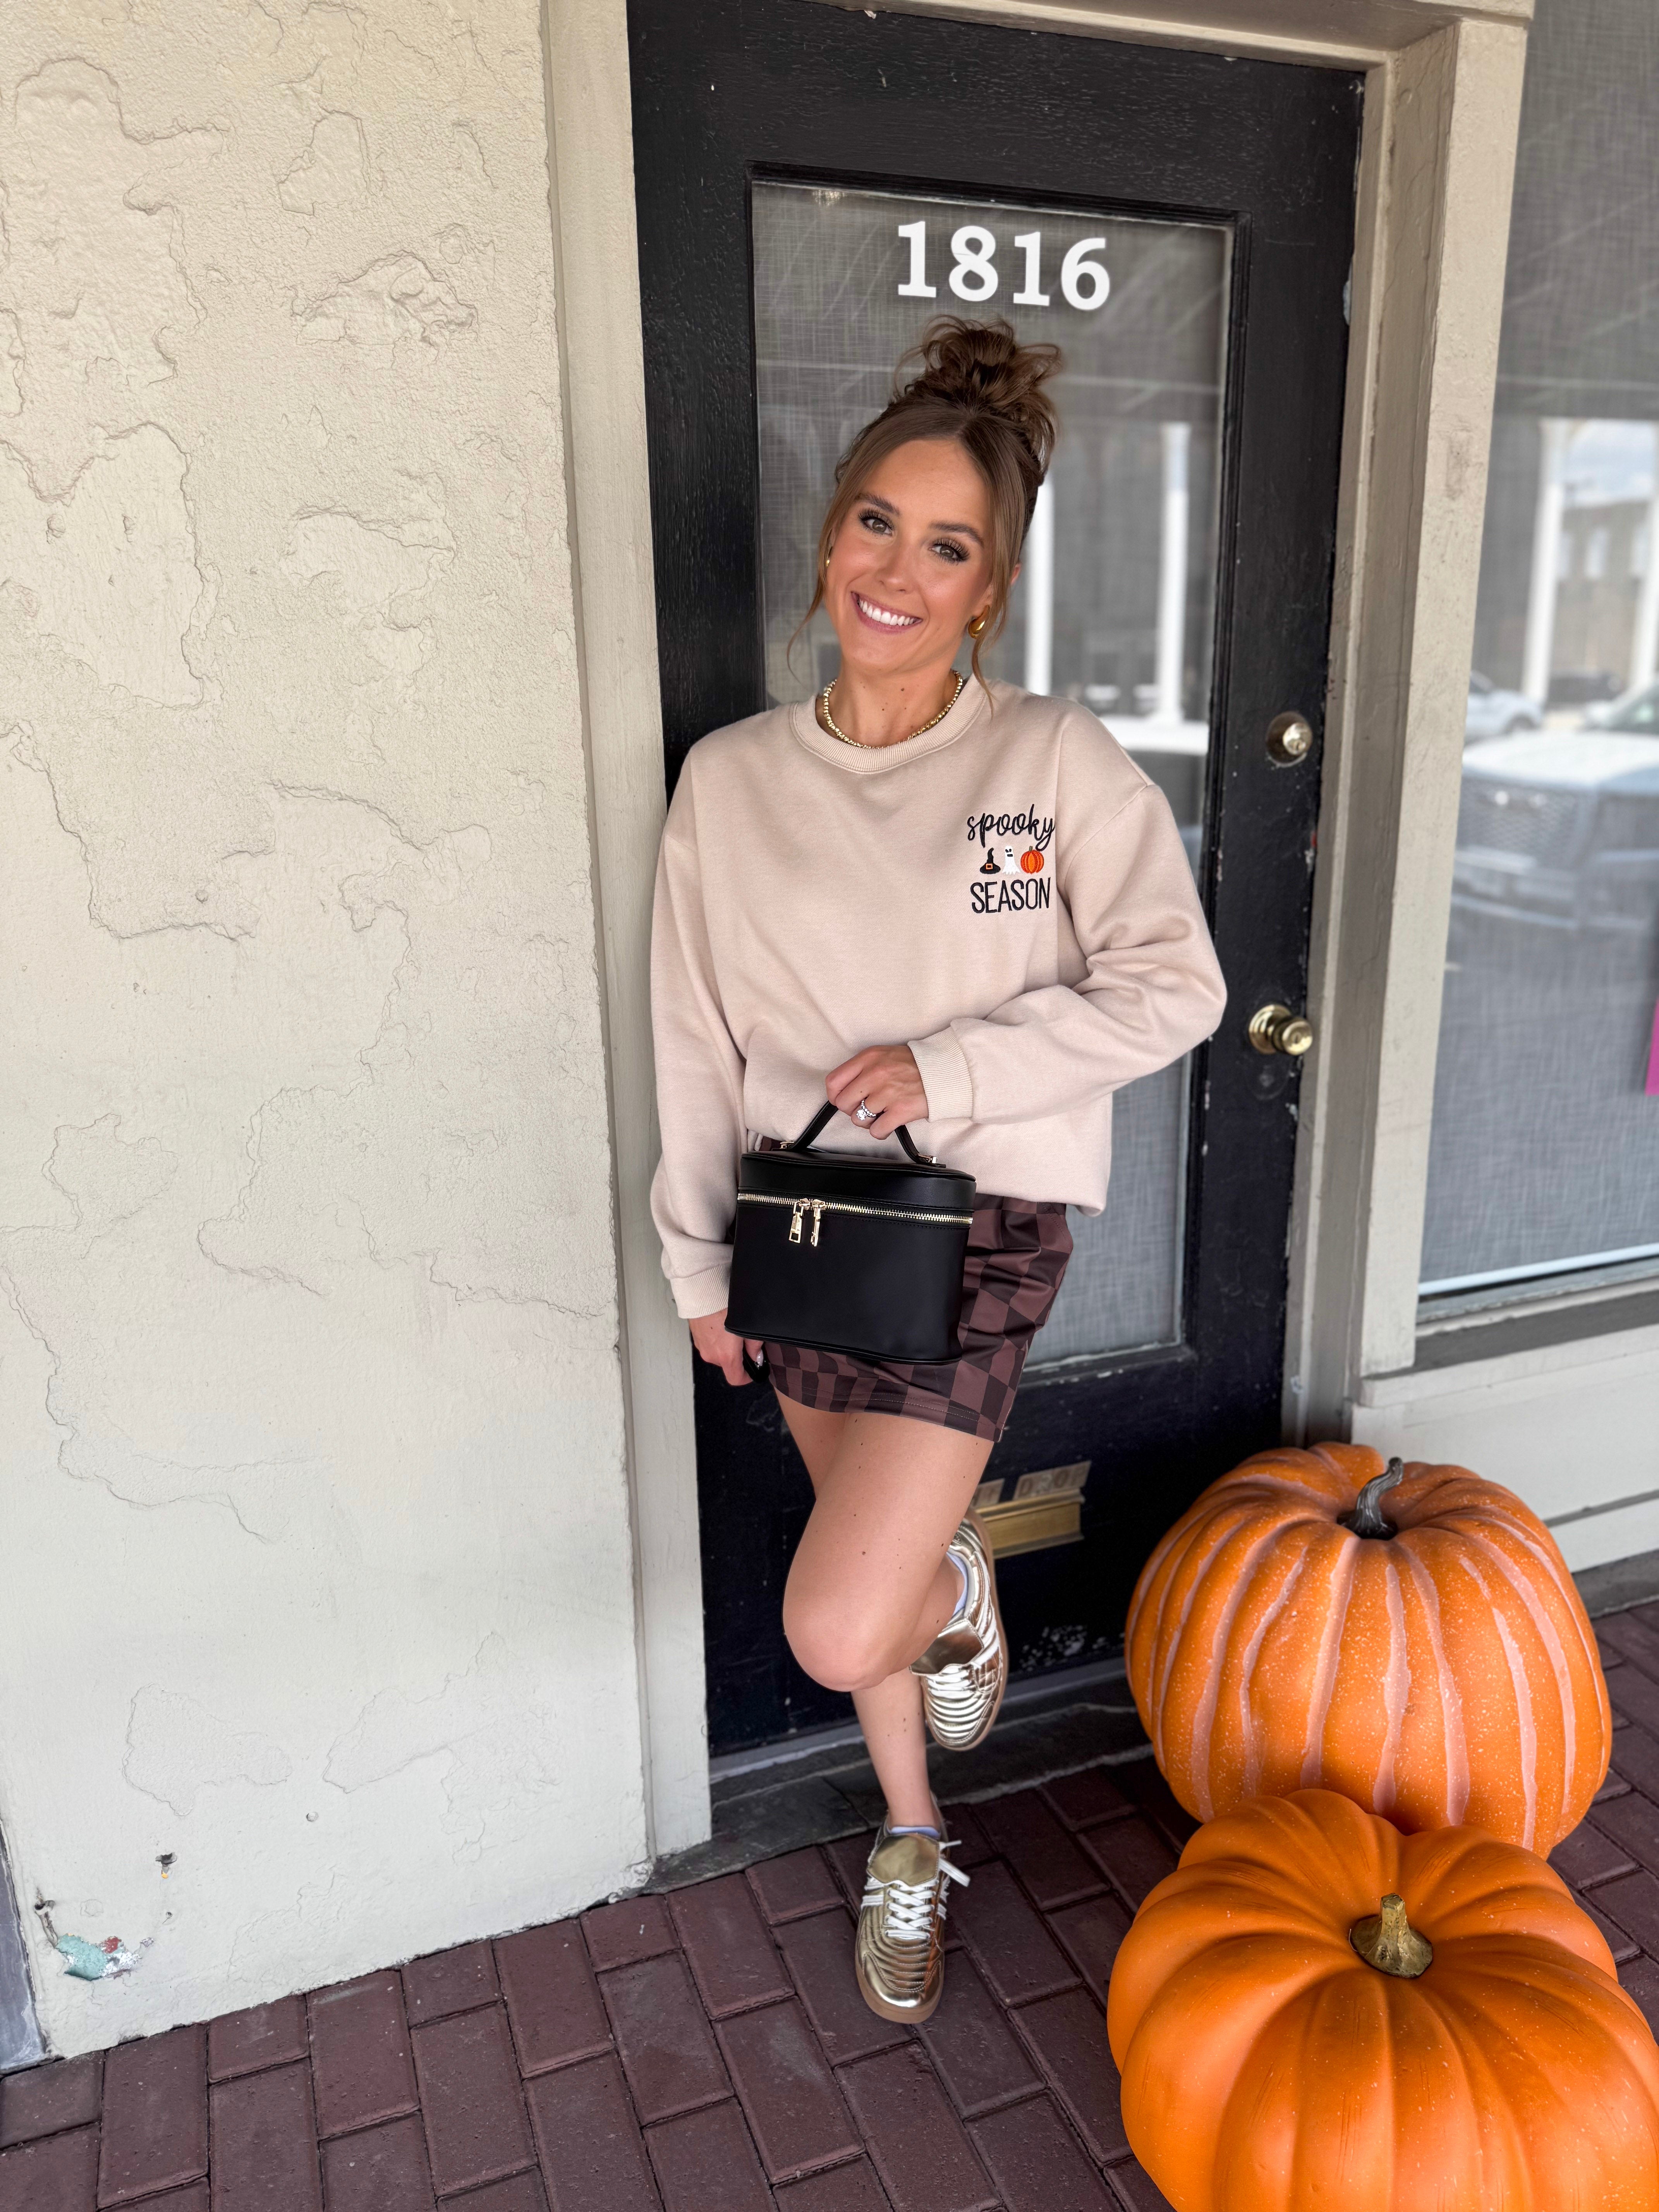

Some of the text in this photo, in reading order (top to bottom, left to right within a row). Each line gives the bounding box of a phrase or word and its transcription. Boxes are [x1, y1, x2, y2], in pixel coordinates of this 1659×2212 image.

[898, 221, 1110, 311] 1816
[967, 804, 1055, 851] spooky
[970, 877, 1051, 914] SEASON
